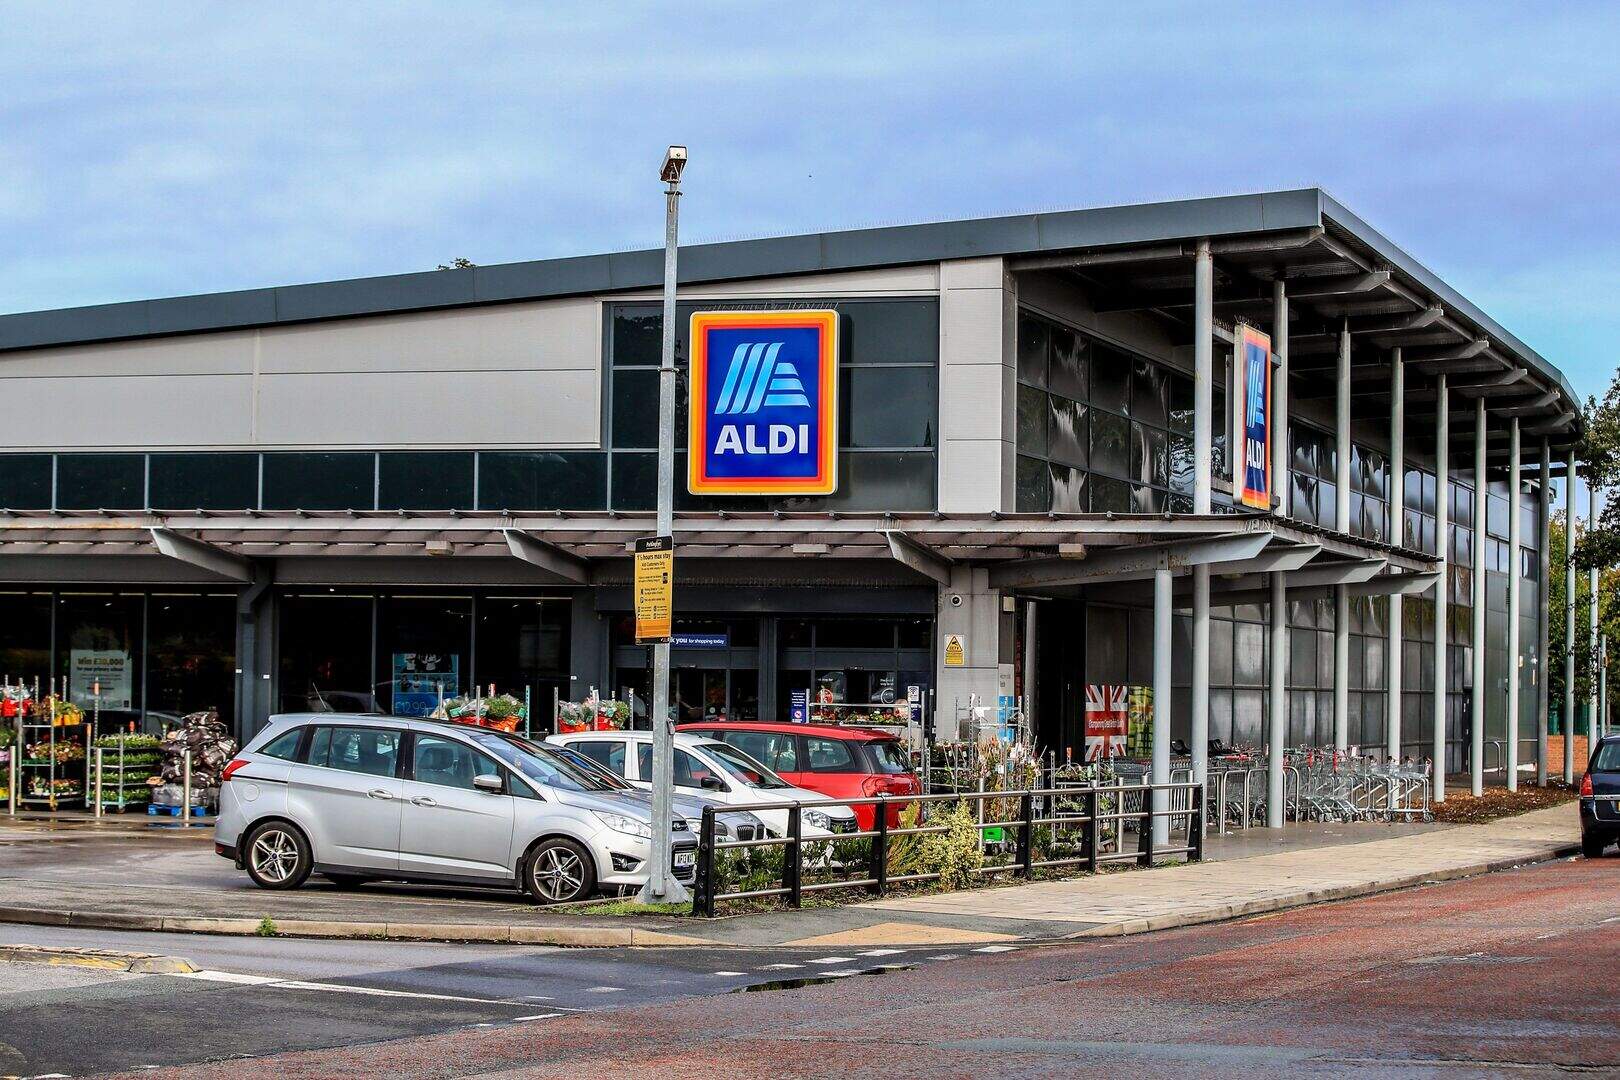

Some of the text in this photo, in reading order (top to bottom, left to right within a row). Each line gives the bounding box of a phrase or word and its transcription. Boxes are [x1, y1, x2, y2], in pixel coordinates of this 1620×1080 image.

[714, 424, 809, 455] ALDI
[1246, 437, 1265, 471] ALDI
[676, 637, 688, 645] you
